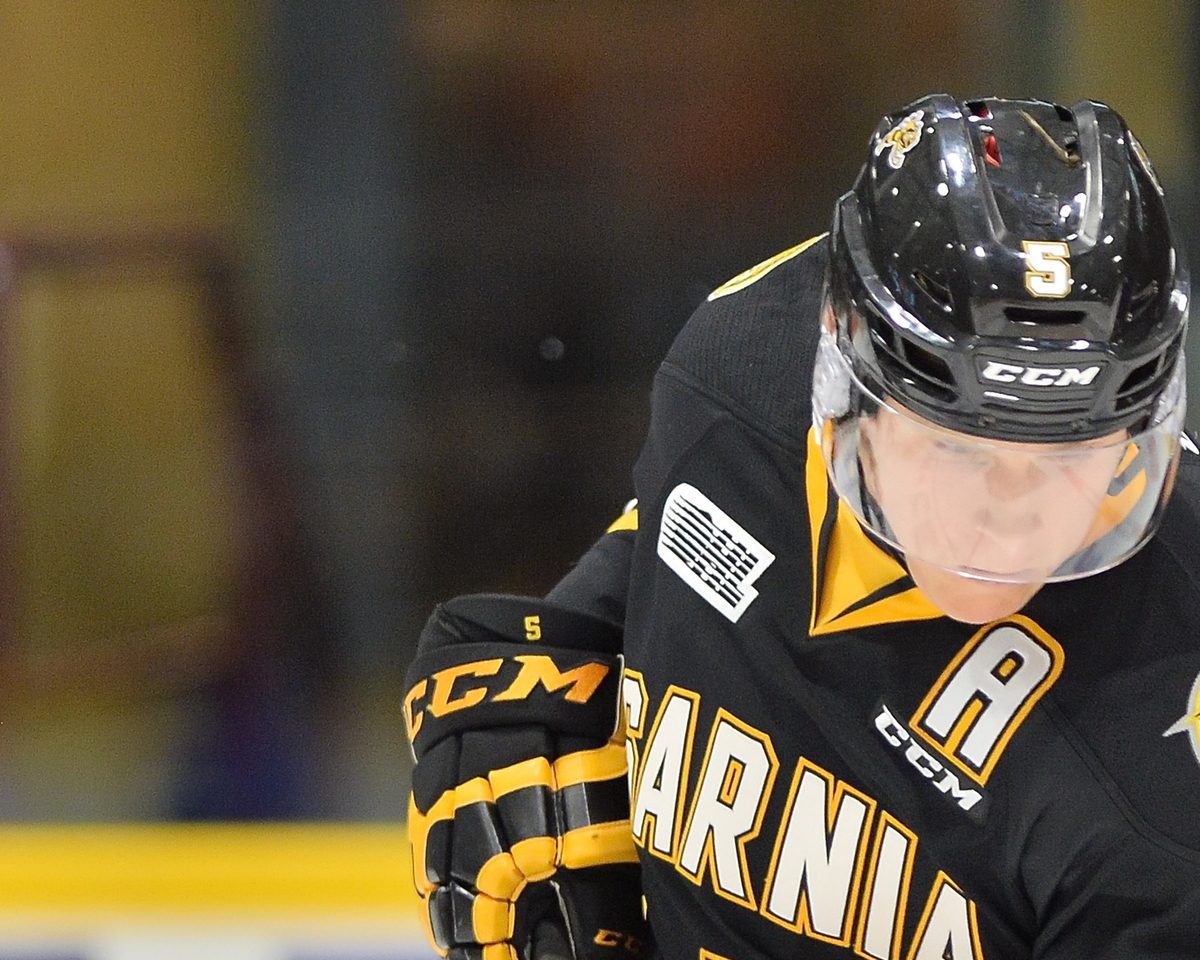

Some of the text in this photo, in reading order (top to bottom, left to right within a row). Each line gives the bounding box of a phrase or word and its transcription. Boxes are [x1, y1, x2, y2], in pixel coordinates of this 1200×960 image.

[1022, 240, 1072, 298] 5
[983, 362, 1101, 386] CCM
[525, 616, 541, 641] 5
[403, 655, 609, 743] CCM
[909, 614, 1065, 787] A
[874, 704, 983, 810] CCM
